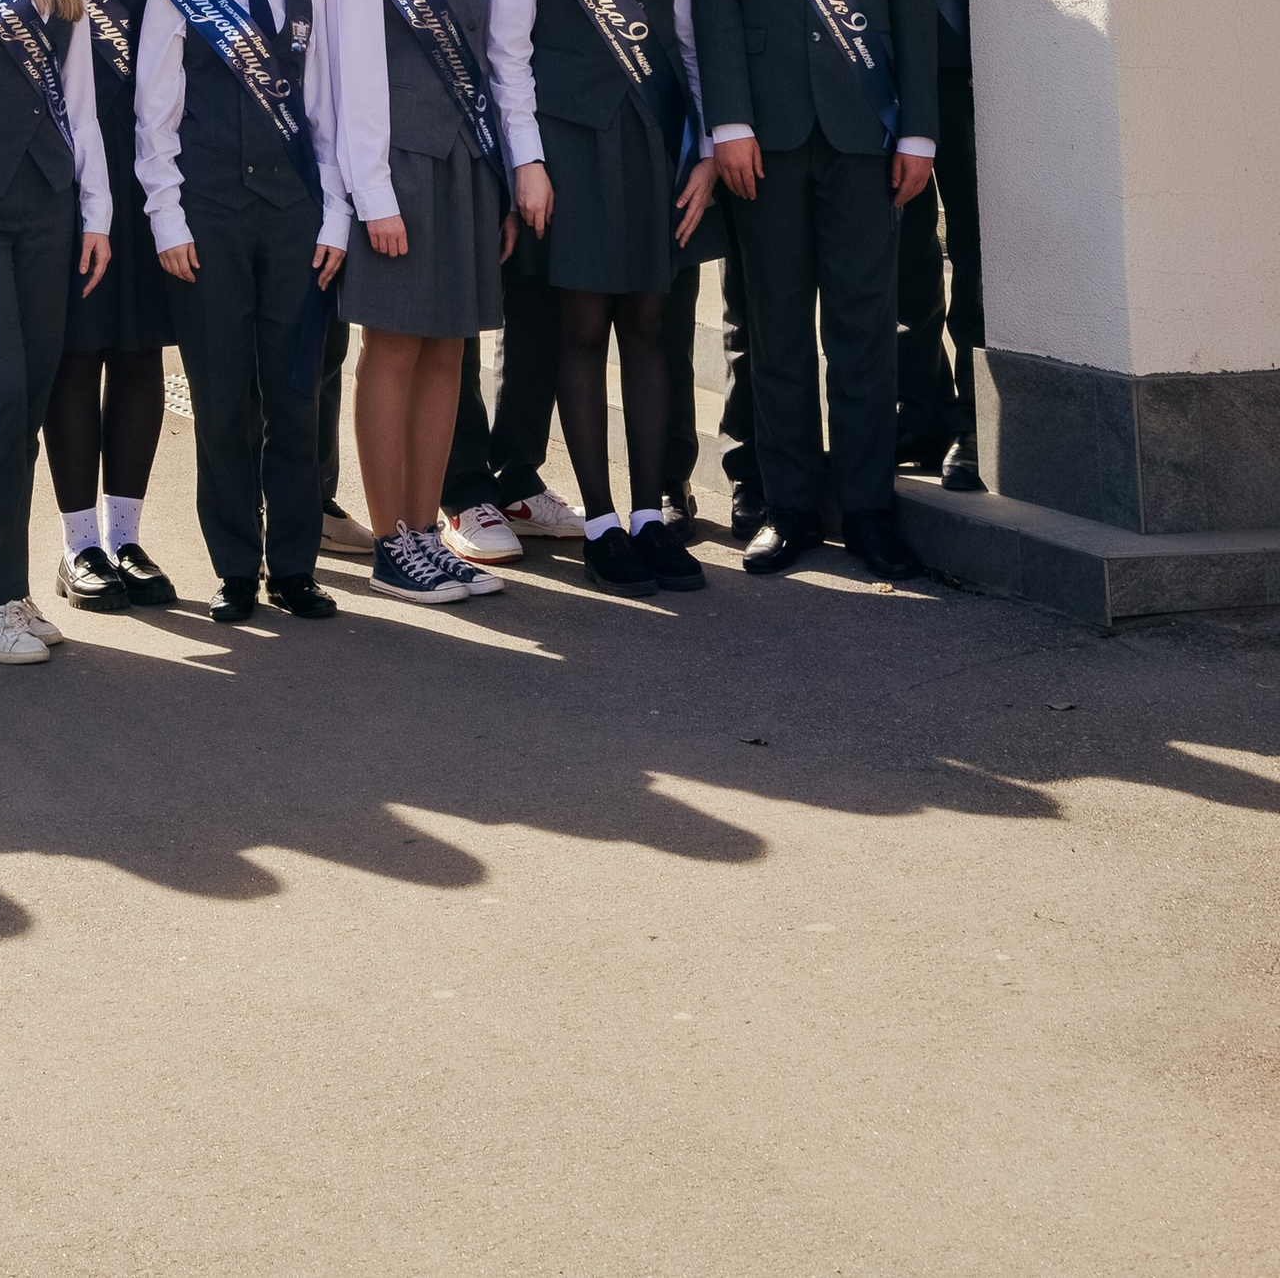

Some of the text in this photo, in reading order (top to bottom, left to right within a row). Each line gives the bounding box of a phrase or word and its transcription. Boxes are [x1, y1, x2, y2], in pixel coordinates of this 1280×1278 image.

[181, 2, 195, 15] год
[403, 6, 416, 20] год
[617, 21, 648, 41] 9
[840, 12, 867, 31] 9
[216, 39, 235, 57] ГАОУ
[229, 55, 243, 69] СО
[249, 35, 270, 58] Дарья
[23, 60, 41, 79] ГАОУ
[265, 79, 291, 97] 9
